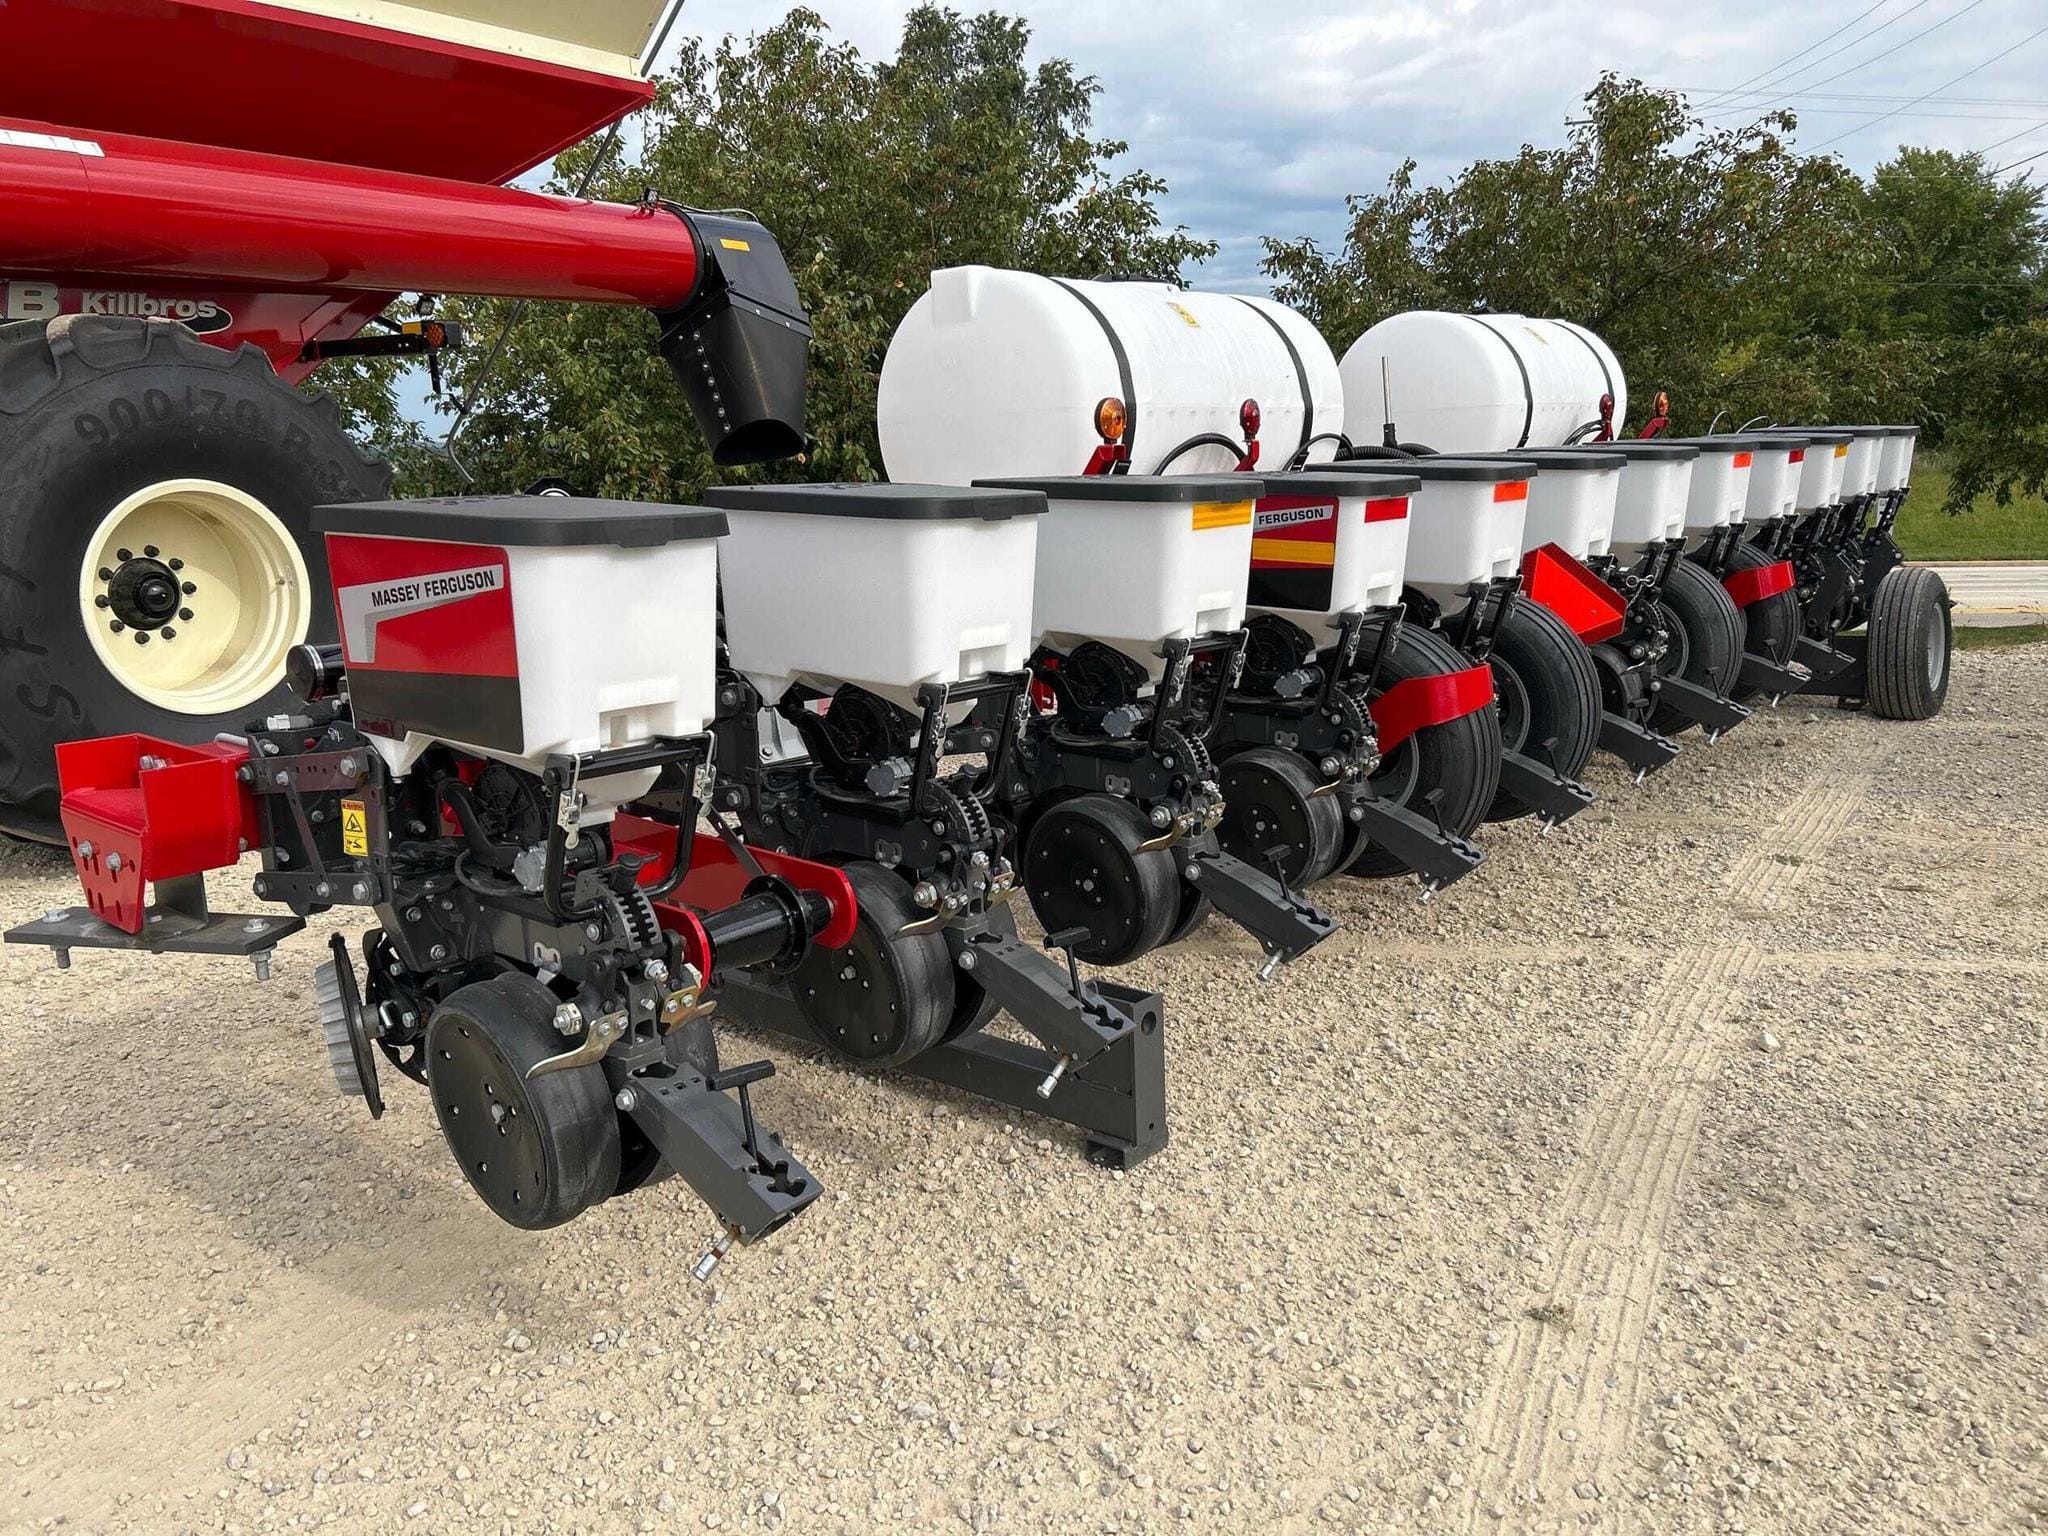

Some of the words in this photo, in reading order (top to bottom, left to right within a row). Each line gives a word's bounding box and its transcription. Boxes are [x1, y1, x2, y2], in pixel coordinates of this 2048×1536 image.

[0, 280, 60, 320] B
[82, 290, 218, 318] Killbros
[1258, 508, 1324, 525] FERGUSON
[371, 583, 421, 607] MASSEY
[424, 569, 496, 598] FERGUSON
